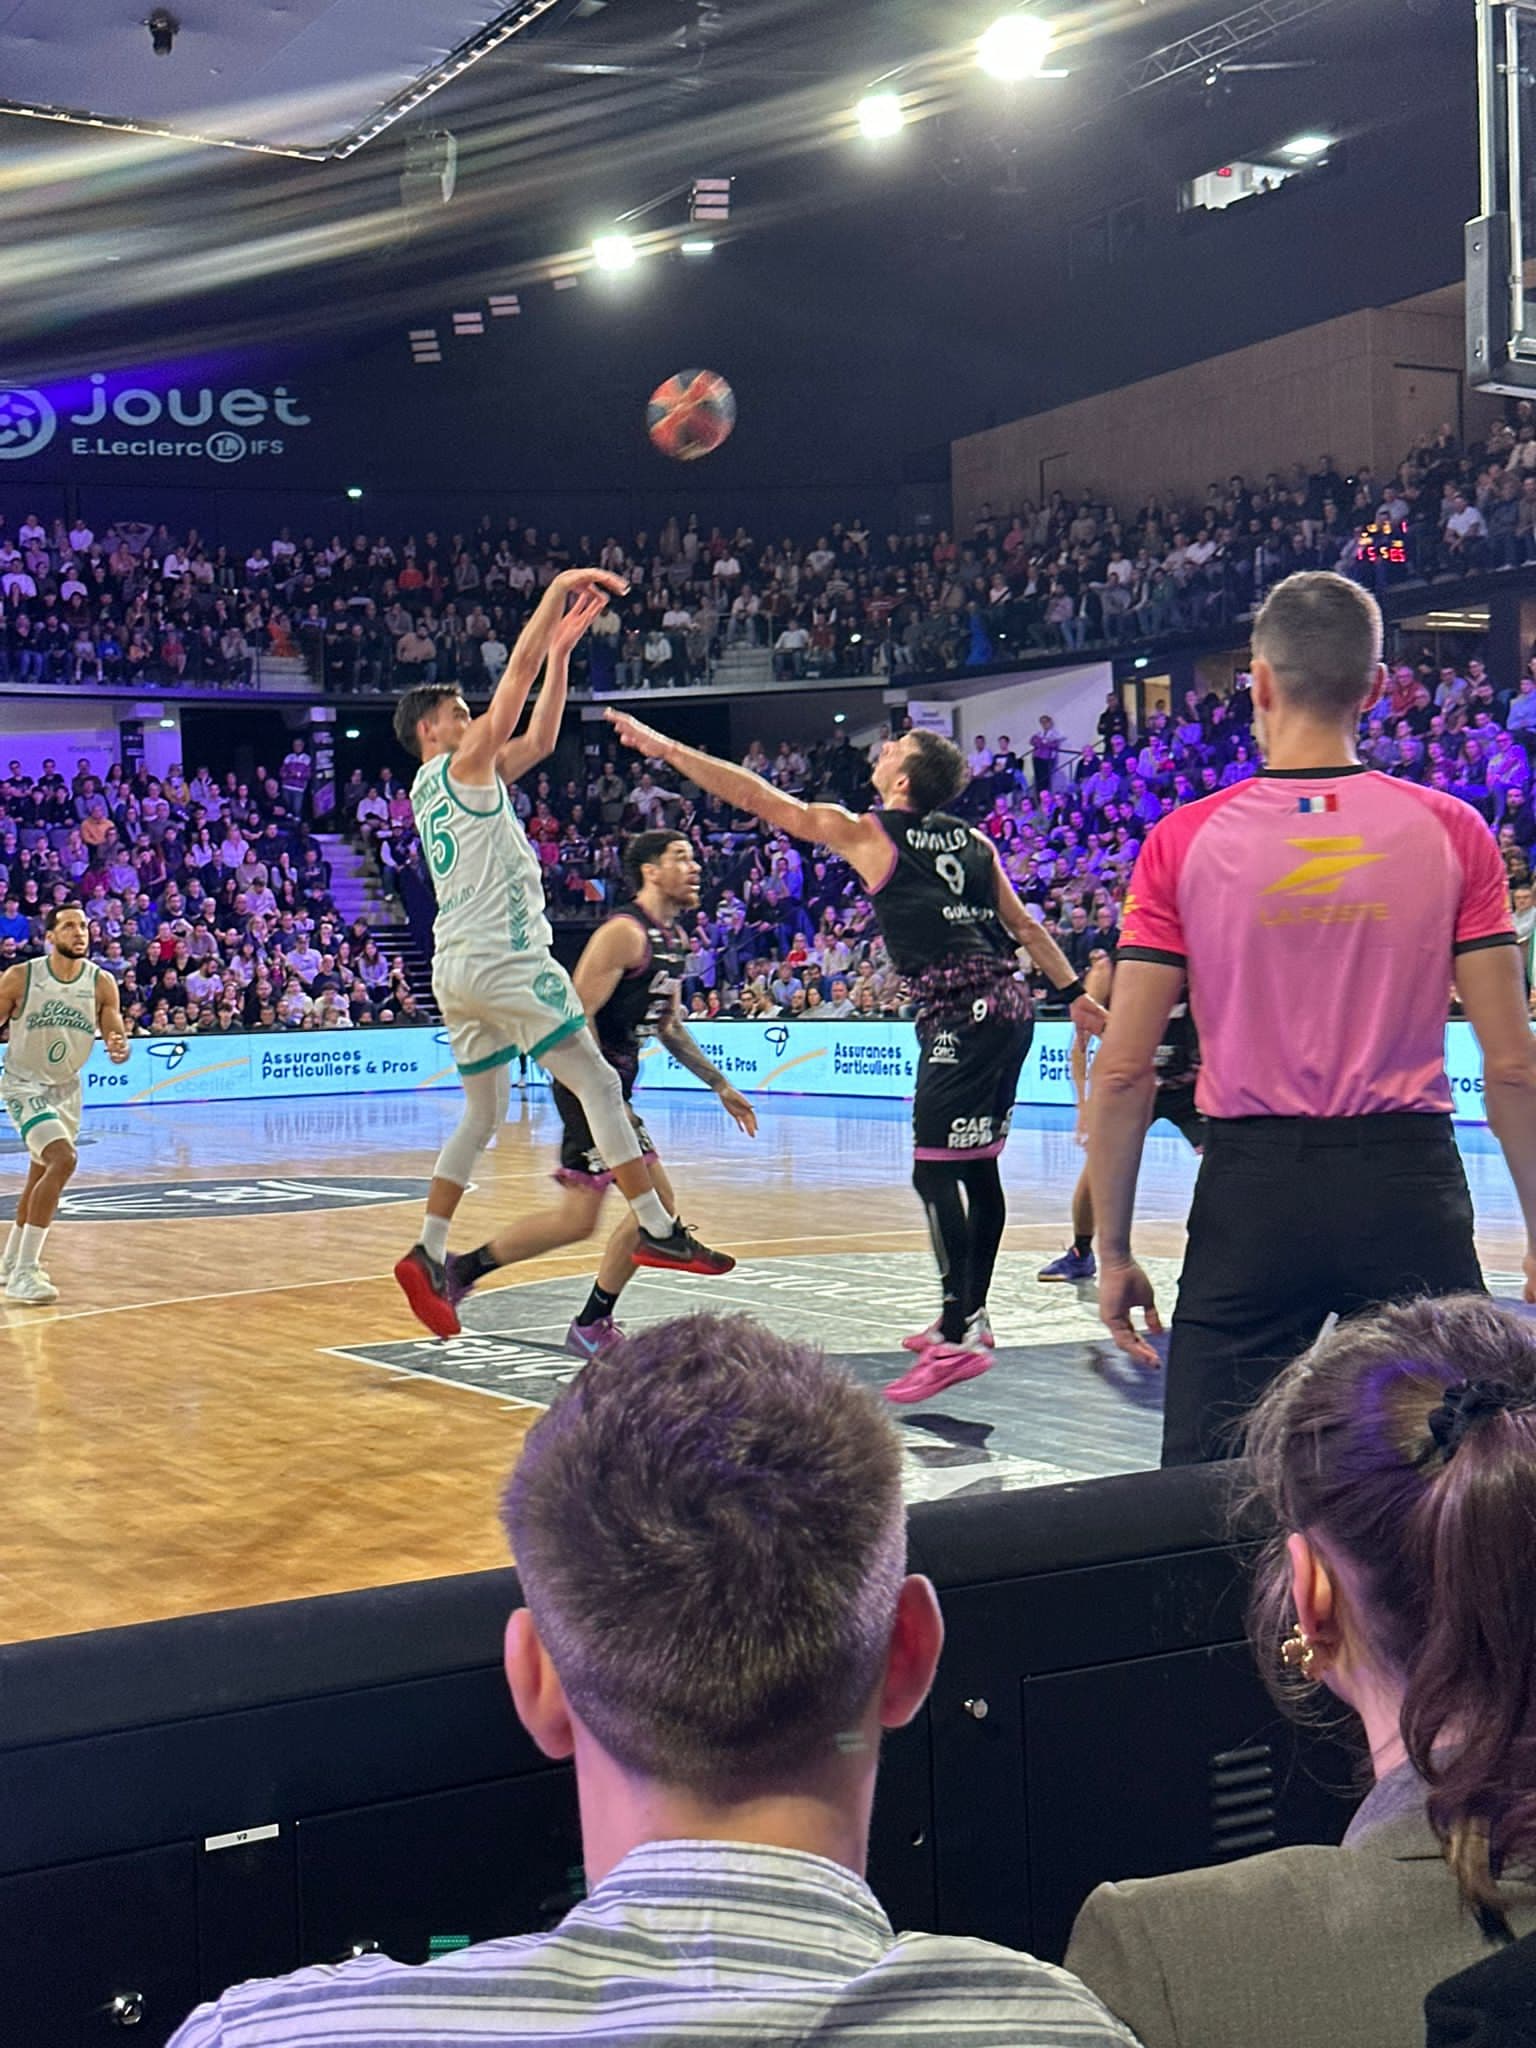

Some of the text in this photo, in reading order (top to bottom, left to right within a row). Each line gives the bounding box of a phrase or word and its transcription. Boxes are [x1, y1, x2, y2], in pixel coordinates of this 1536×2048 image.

[71, 373, 311, 427] jouet
[71, 438, 203, 456] E.Leclerc
[251, 440, 284, 454] IFS
[935, 853, 965, 896] 9
[972, 999, 988, 1022] 9
[48, 1040, 66, 1063] 0
[262, 1050, 362, 1065] Assurances
[834, 1042, 902, 1059] Assurances
[262, 1060, 419, 1080] Particuliers & Pros
[735, 1057, 757, 1072] Pros
[834, 1059, 901, 1076] Particuliers
[88, 1073, 129, 1088] Pros
[1450, 1077, 1485, 1093] ros
